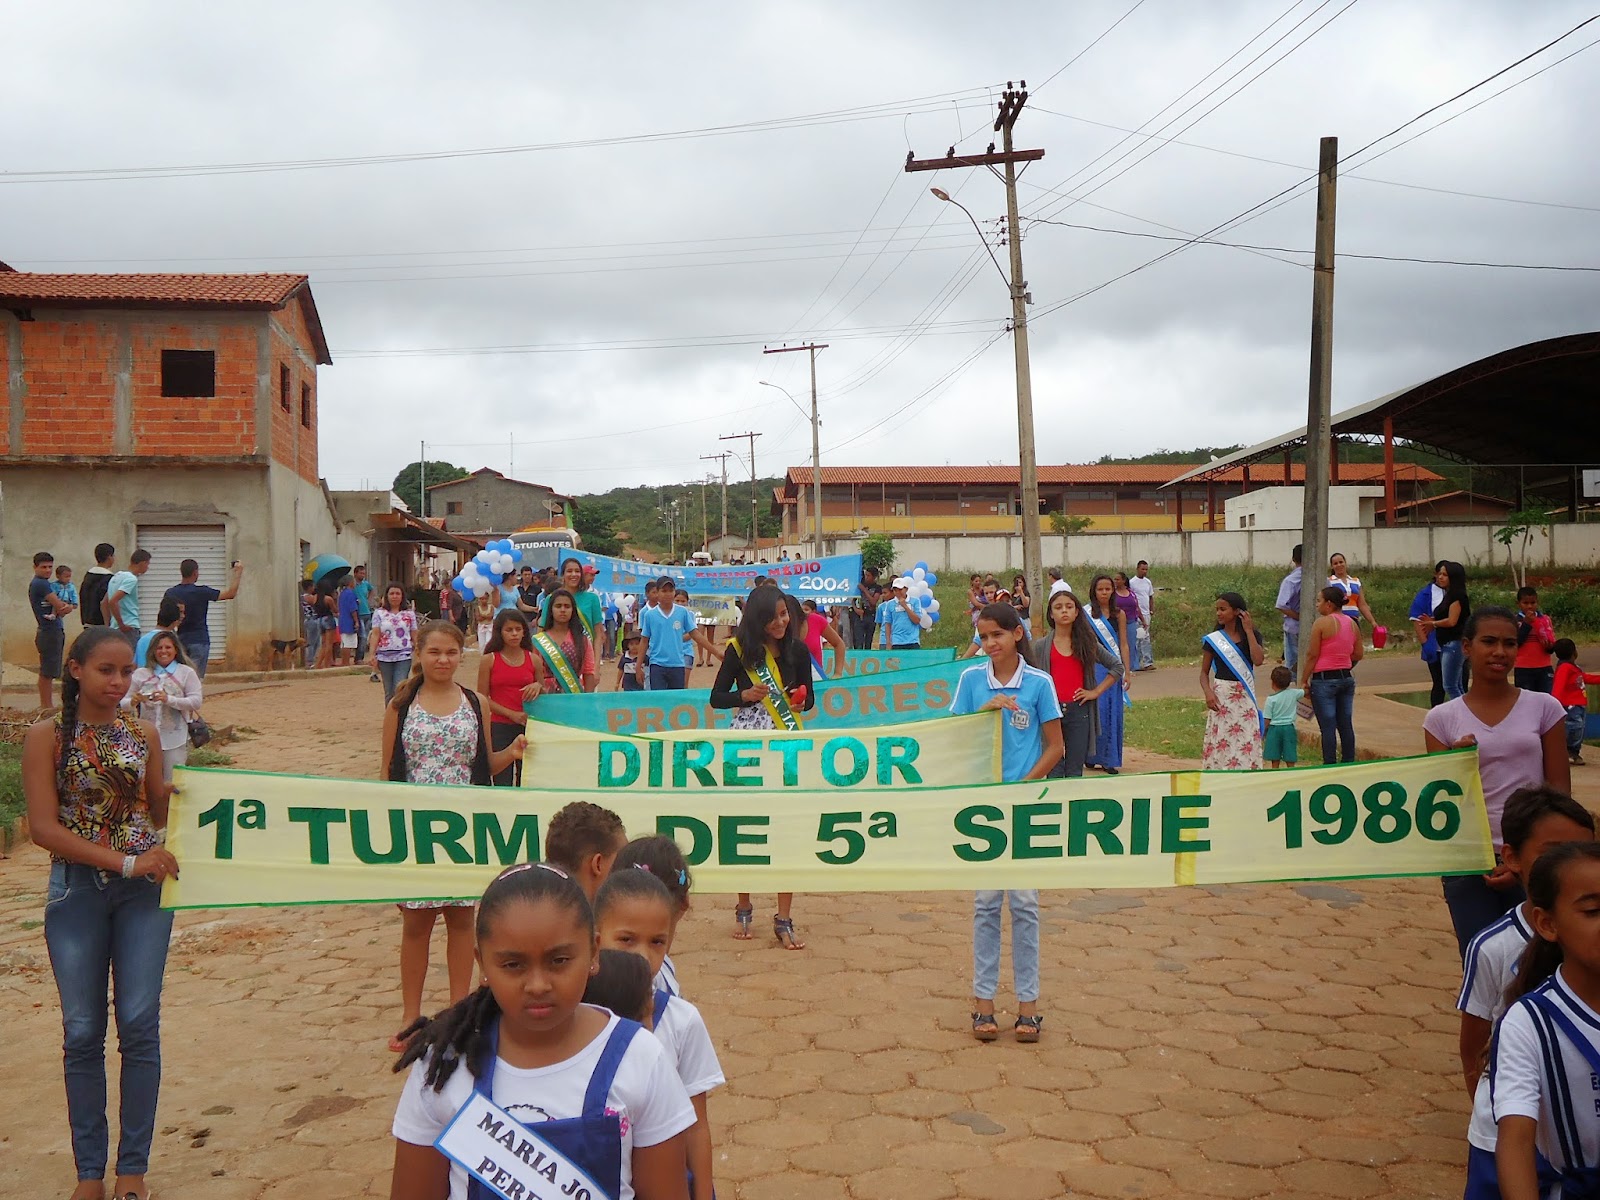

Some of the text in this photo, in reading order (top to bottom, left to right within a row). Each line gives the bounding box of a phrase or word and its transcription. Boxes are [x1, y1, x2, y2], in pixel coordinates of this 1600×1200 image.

[514, 541, 571, 550] STUDANTES
[695, 571, 758, 579] ENSINO
[799, 576, 849, 592] 2004
[688, 599, 729, 610] RETORA
[606, 679, 951, 733] PROFORES
[597, 736, 923, 788] DIRETOR
[198, 780, 1463, 867] 1ª TURM DE 5ª SÉRIE 1986
[476, 1111, 558, 1185] MARIA
